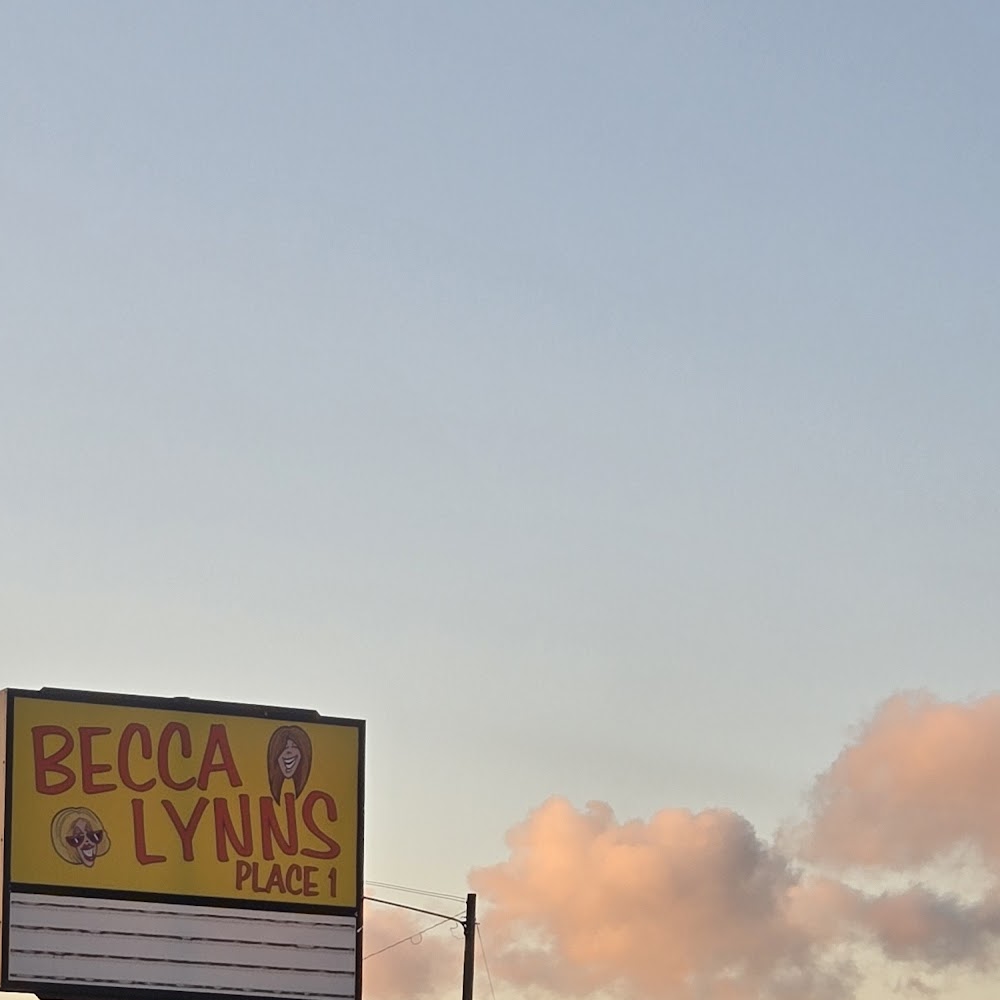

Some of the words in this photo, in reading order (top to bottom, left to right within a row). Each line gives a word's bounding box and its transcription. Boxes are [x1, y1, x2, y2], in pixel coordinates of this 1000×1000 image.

[32, 722, 243, 795] BECCA
[131, 790, 341, 865] LYNNS
[236, 860, 318, 896] PLACE
[328, 867, 337, 897] 1
